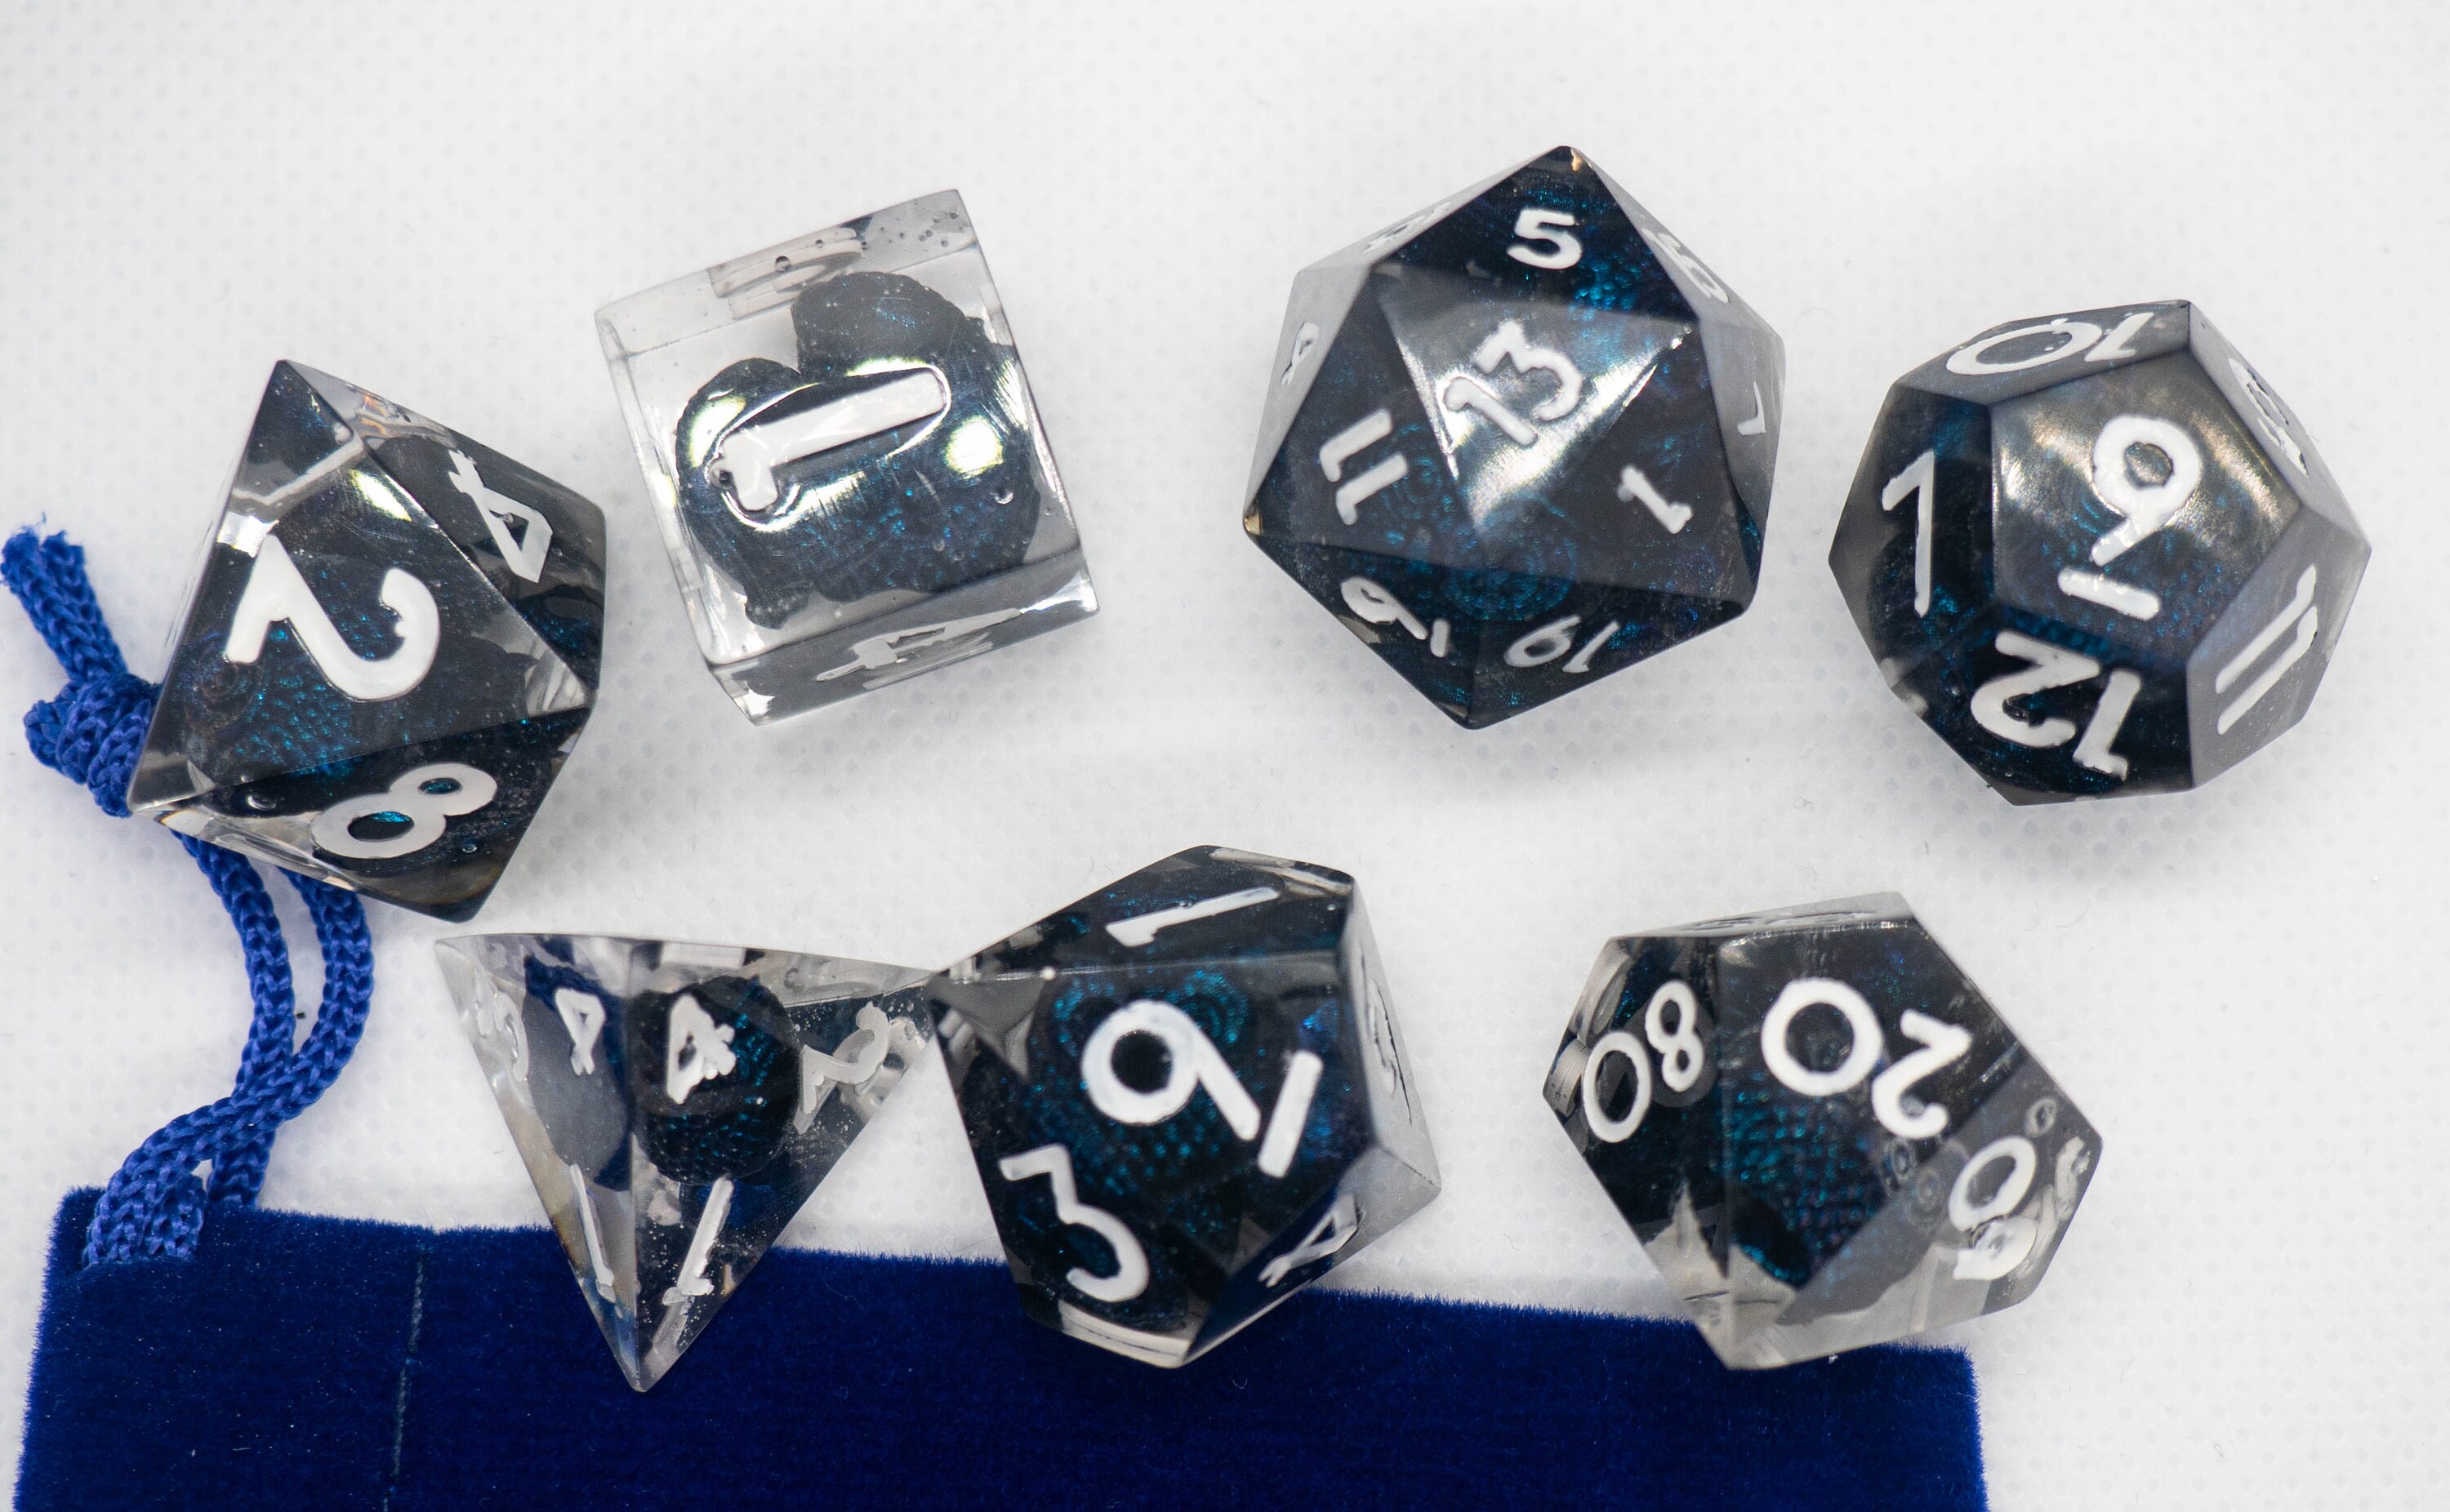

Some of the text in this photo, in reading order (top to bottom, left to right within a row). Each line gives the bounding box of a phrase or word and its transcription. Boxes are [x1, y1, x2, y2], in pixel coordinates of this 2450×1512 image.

[1507, 208, 1583, 269] 5
[1444, 322, 1584, 446] 13
[1946, 311, 2156, 376] 10
[710, 372, 944, 511] 1
[1319, 408, 1410, 526] 11
[1617, 465, 1693, 534] 1
[448, 450, 554, 583] 4
[2056, 414, 2203, 622] 9
[225, 533, 440, 702] 2
[1503, 616, 1620, 674] 19
[2215, 564, 2319, 736] 11
[1970, 630, 2142, 781] 12
[310, 761, 497, 860] 8
[1106, 887, 1281, 949] 1
[553, 985, 607, 1078] 4
[666, 993, 737, 1105] 4
[799, 1000, 893, 1118] 2
[1081, 998, 1324, 1179] 9
[1581, 979, 1706, 1144] 80
[1760, 977, 1973, 1140] 20
[571, 1163, 614, 1294] 1
[675, 1174, 735, 1296] 1
[1000, 1144, 1150, 1303] 3
[1258, 1192, 1362, 1288] 4
